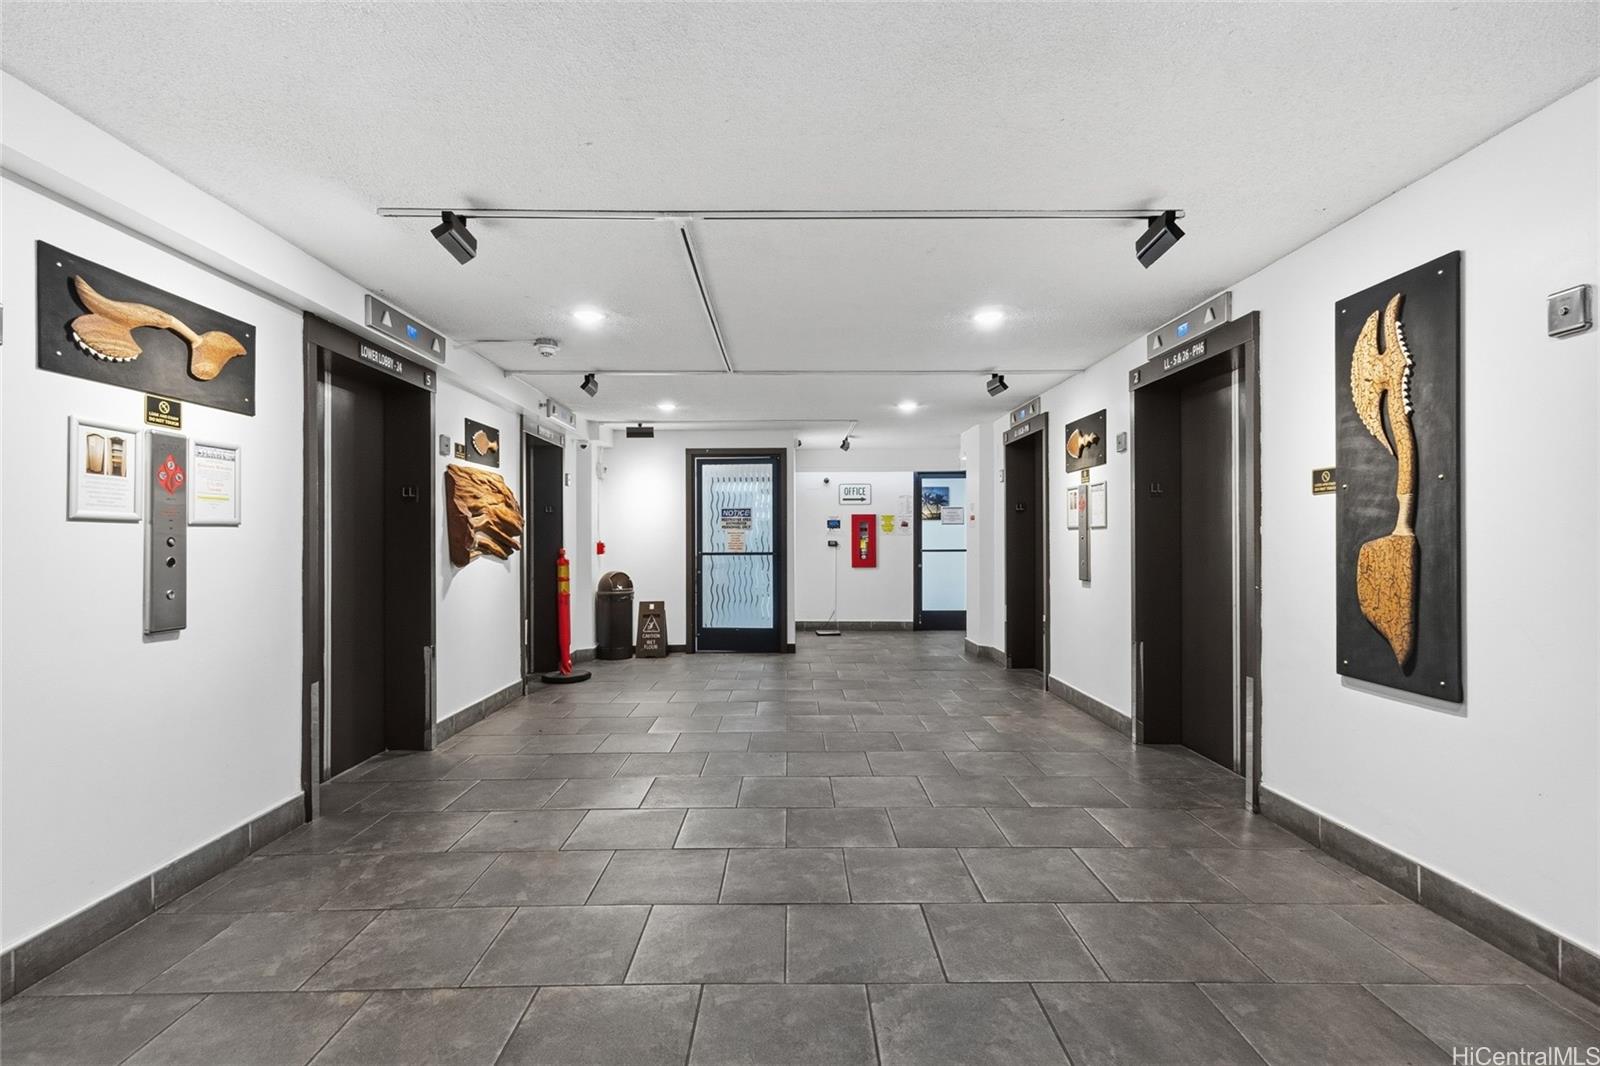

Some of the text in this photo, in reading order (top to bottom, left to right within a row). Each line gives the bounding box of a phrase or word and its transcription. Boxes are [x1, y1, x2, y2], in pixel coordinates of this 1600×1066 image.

[361, 344, 379, 363] LOWER
[379, 352, 394, 370] LOBBY
[1133, 372, 1139, 384] 2
[402, 487, 416, 497] LL
[844, 487, 866, 496] OFFICE
[1151, 482, 1164, 493] LL
